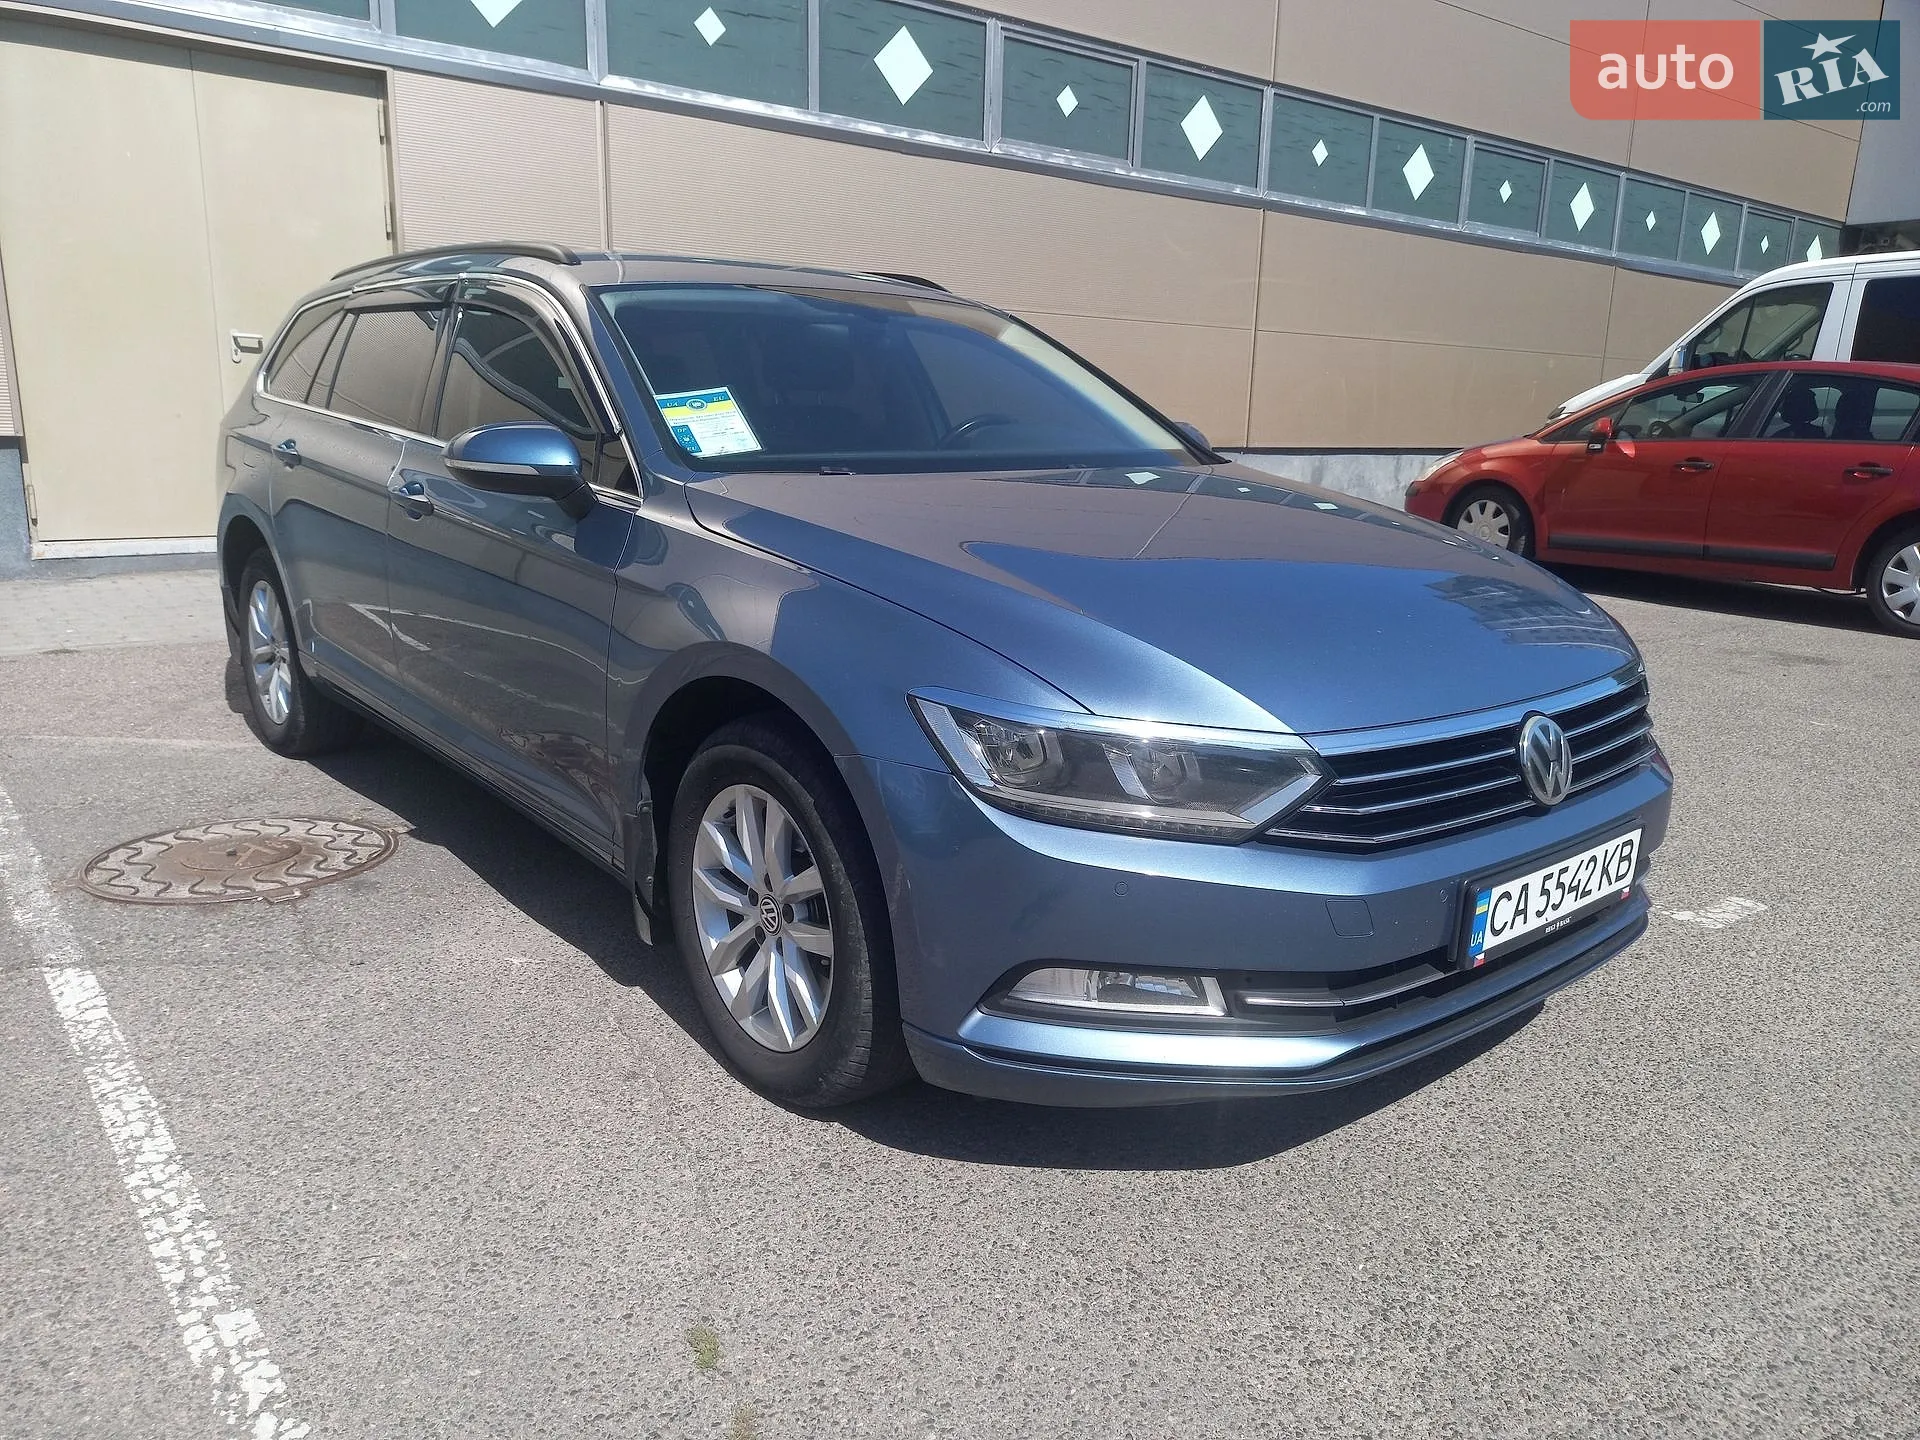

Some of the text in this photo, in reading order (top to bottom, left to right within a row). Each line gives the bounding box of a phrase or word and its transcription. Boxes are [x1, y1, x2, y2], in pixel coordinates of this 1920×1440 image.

[1490, 838, 1634, 937] CA 5542 KB
[1470, 931, 1483, 947] UA
